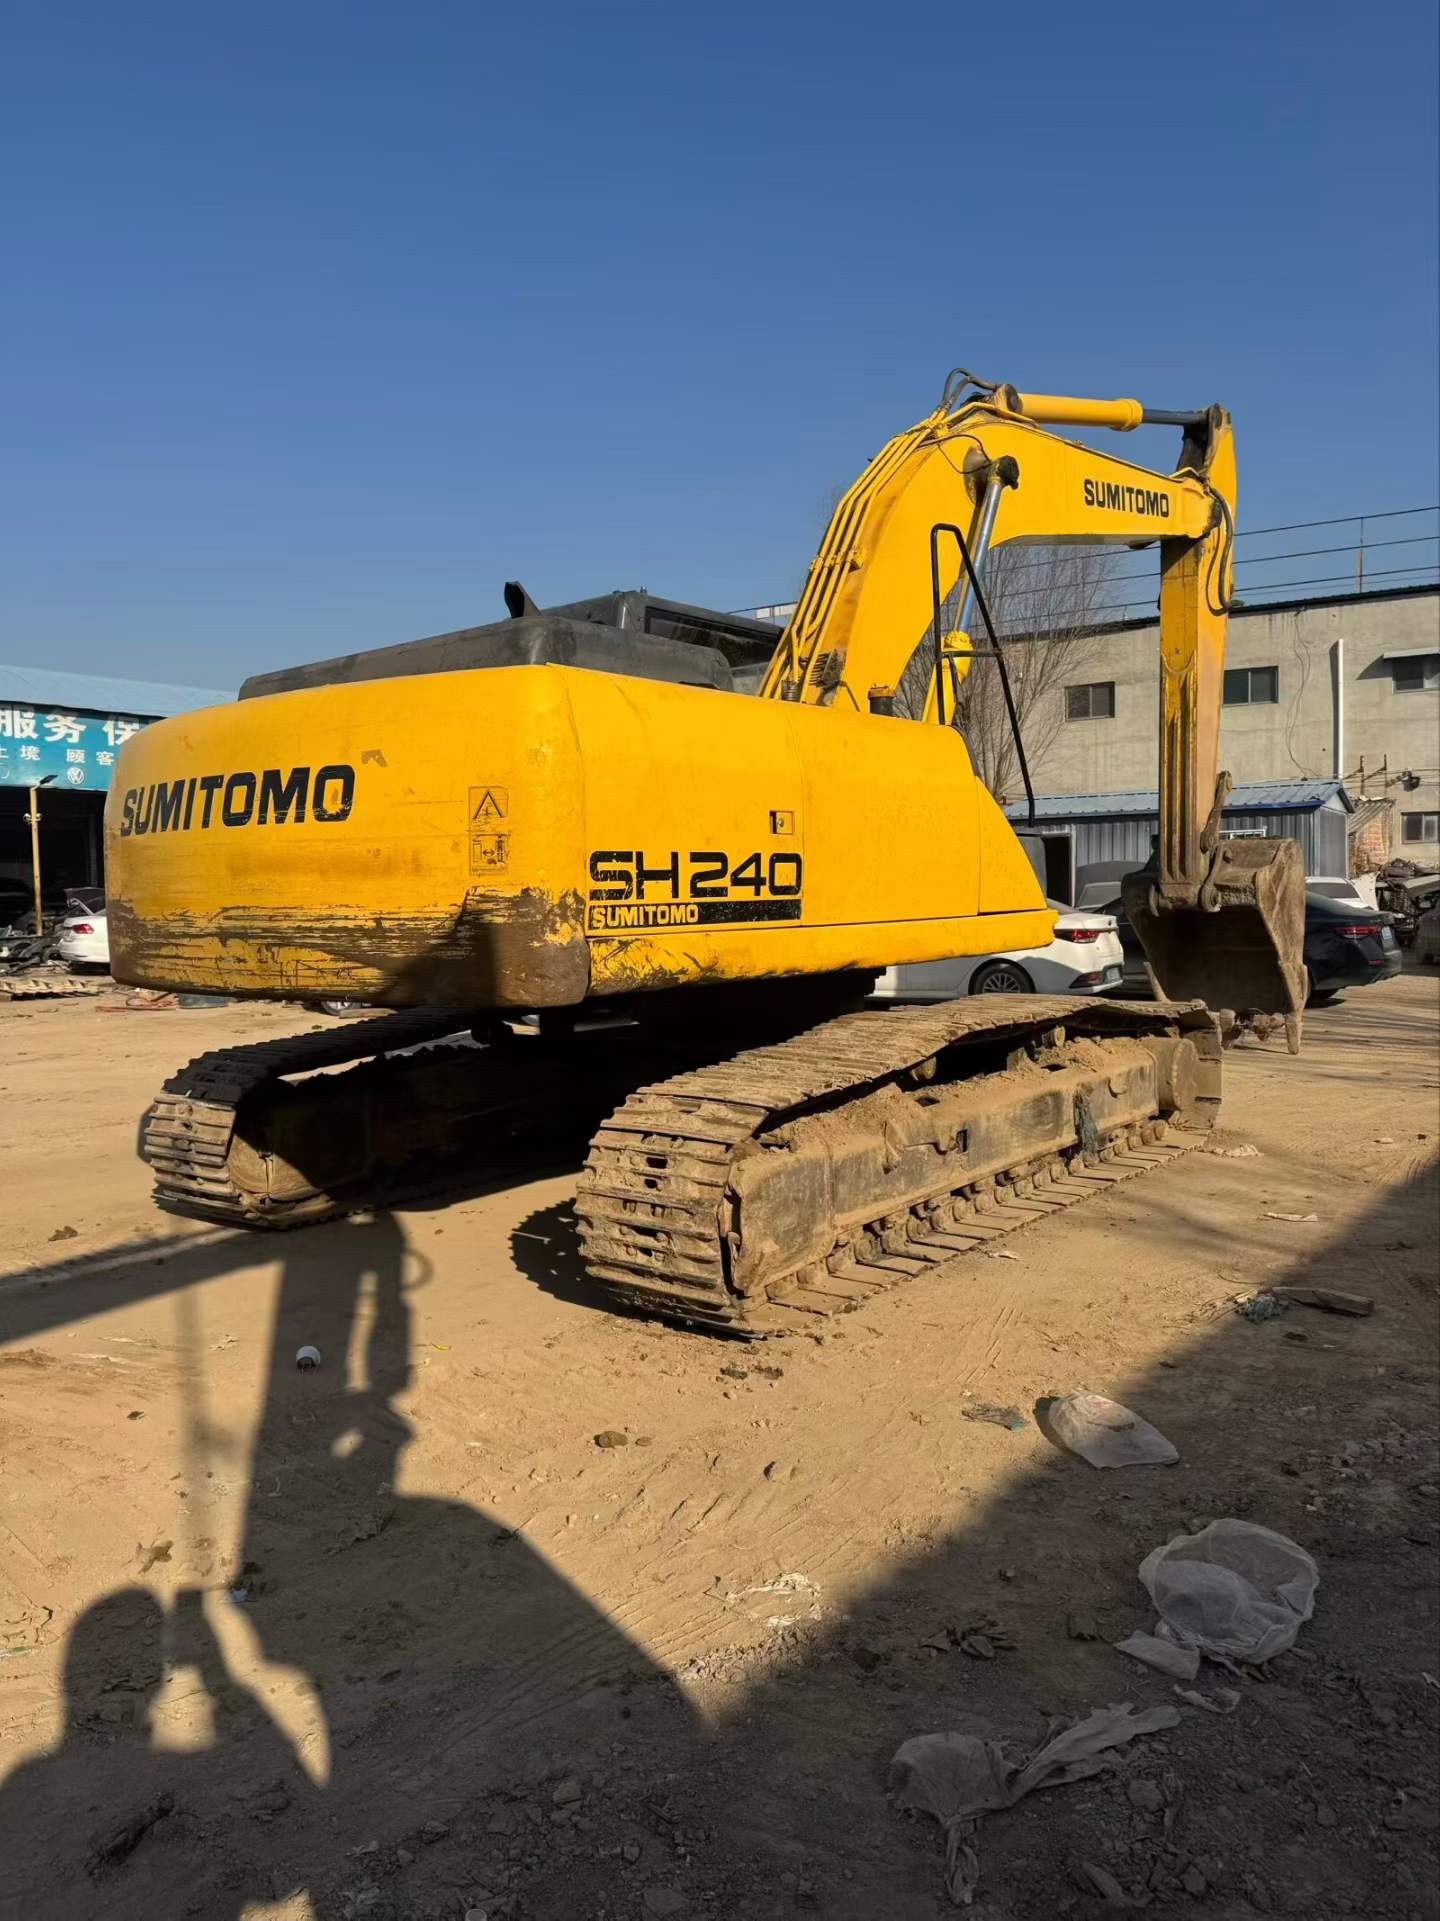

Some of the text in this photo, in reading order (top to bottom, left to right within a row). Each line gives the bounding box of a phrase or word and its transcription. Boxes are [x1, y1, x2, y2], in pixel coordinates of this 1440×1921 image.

[1084, 479, 1170, 518] SUMITOMO
[66, 749, 114, 766] 顾客
[120, 764, 355, 837] SUMITOMO
[592, 904, 699, 929] SUMITOMO
